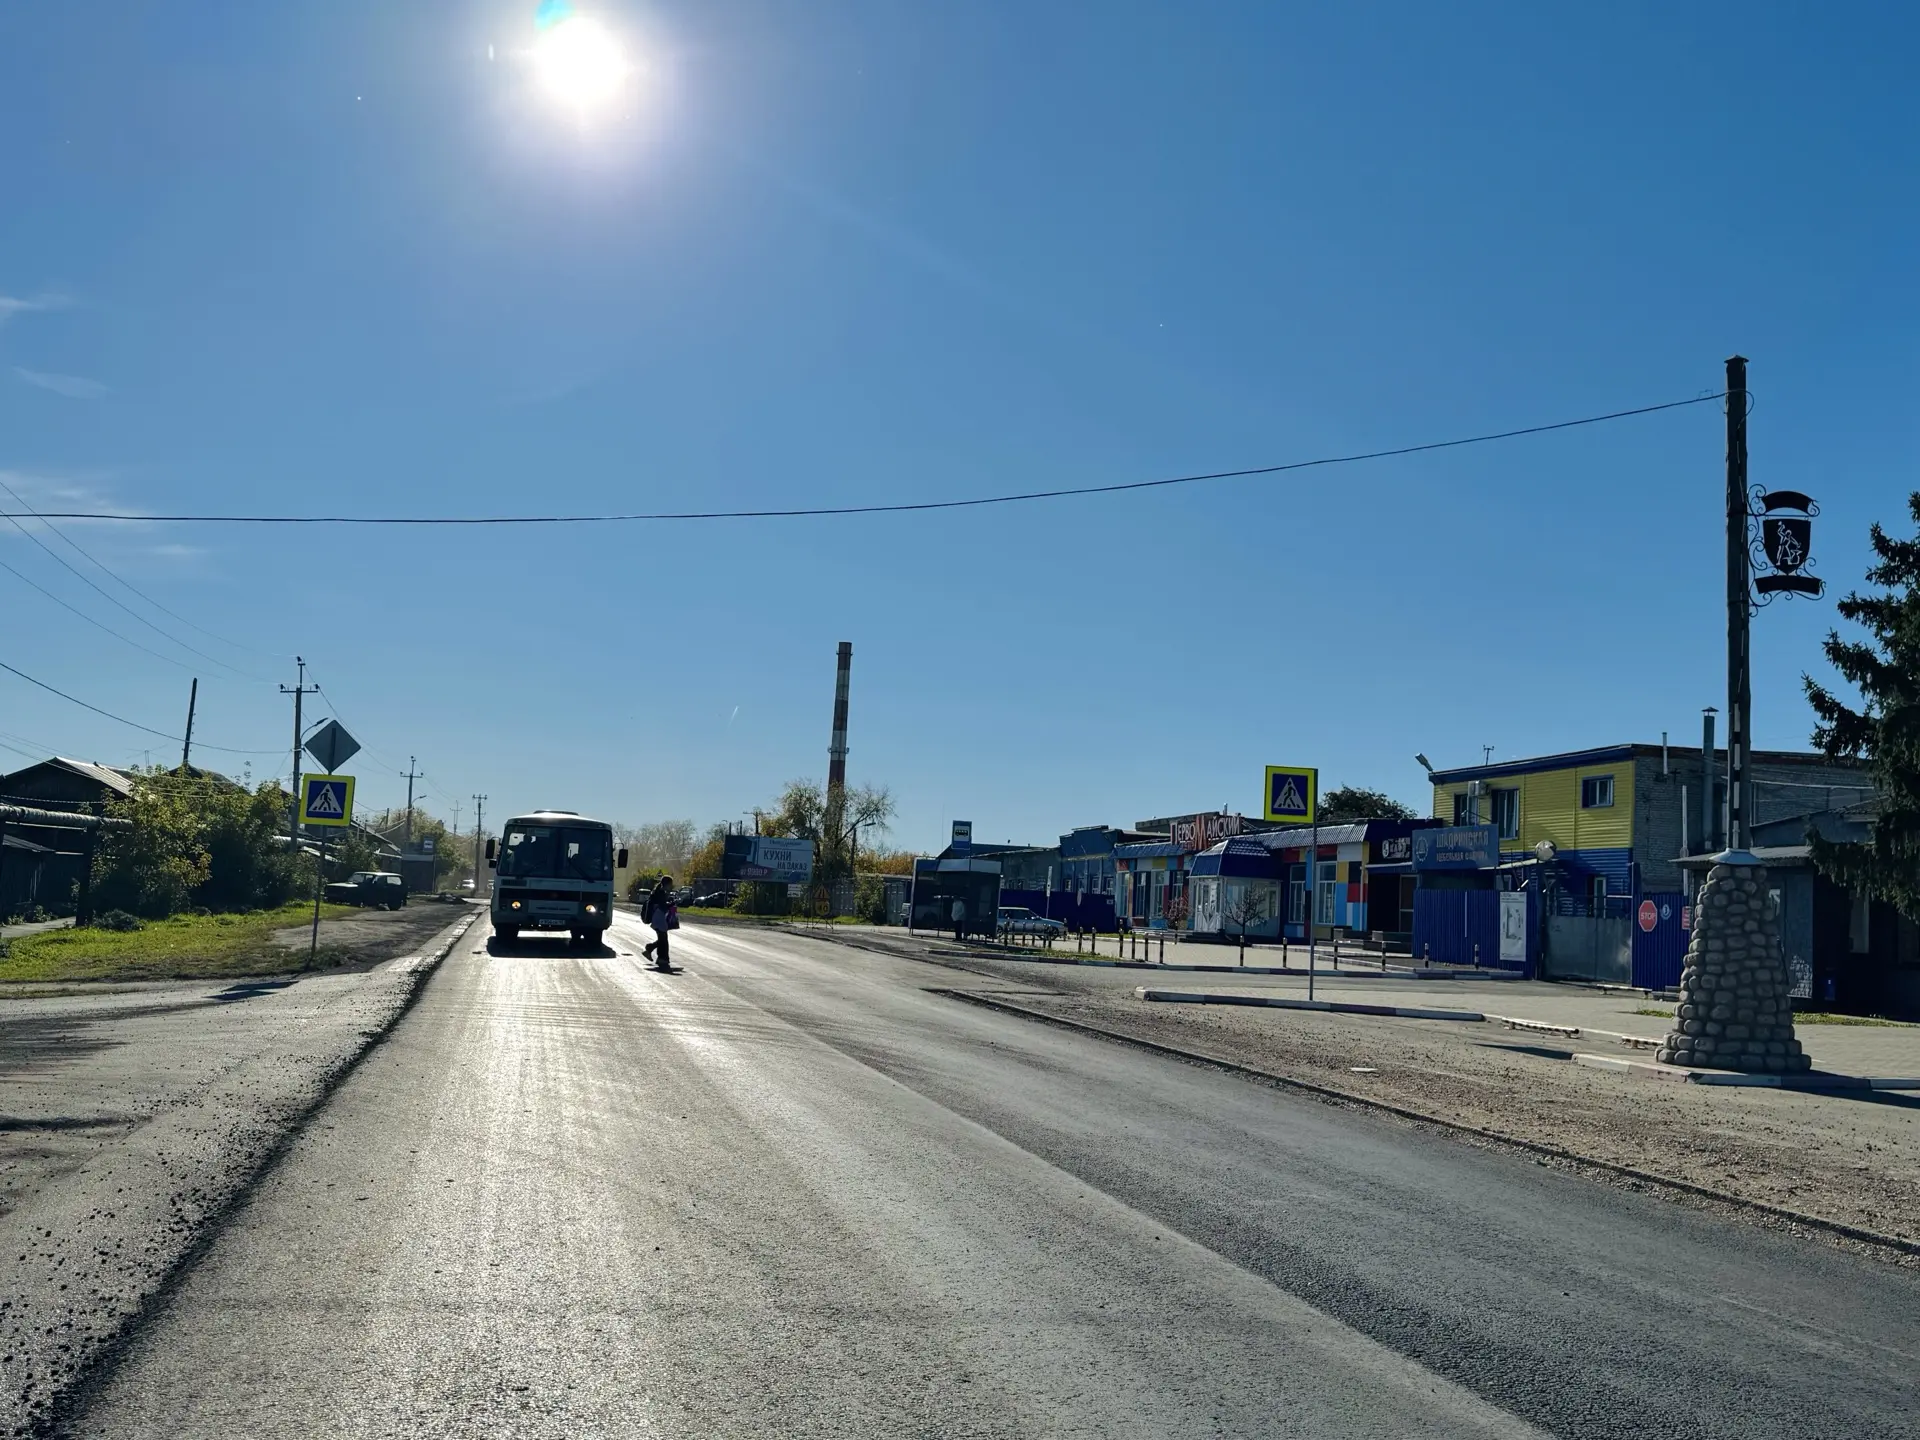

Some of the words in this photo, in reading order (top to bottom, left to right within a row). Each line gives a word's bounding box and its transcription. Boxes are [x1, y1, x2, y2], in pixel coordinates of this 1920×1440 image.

[1436, 831, 1489, 849] ШАДРИНСКАЯ
[764, 850, 792, 861] КУХНИ
[777, 862, 786, 870] НА
[787, 862, 808, 871] ЗАКАЗ
[1640, 911, 1656, 920] STOP
